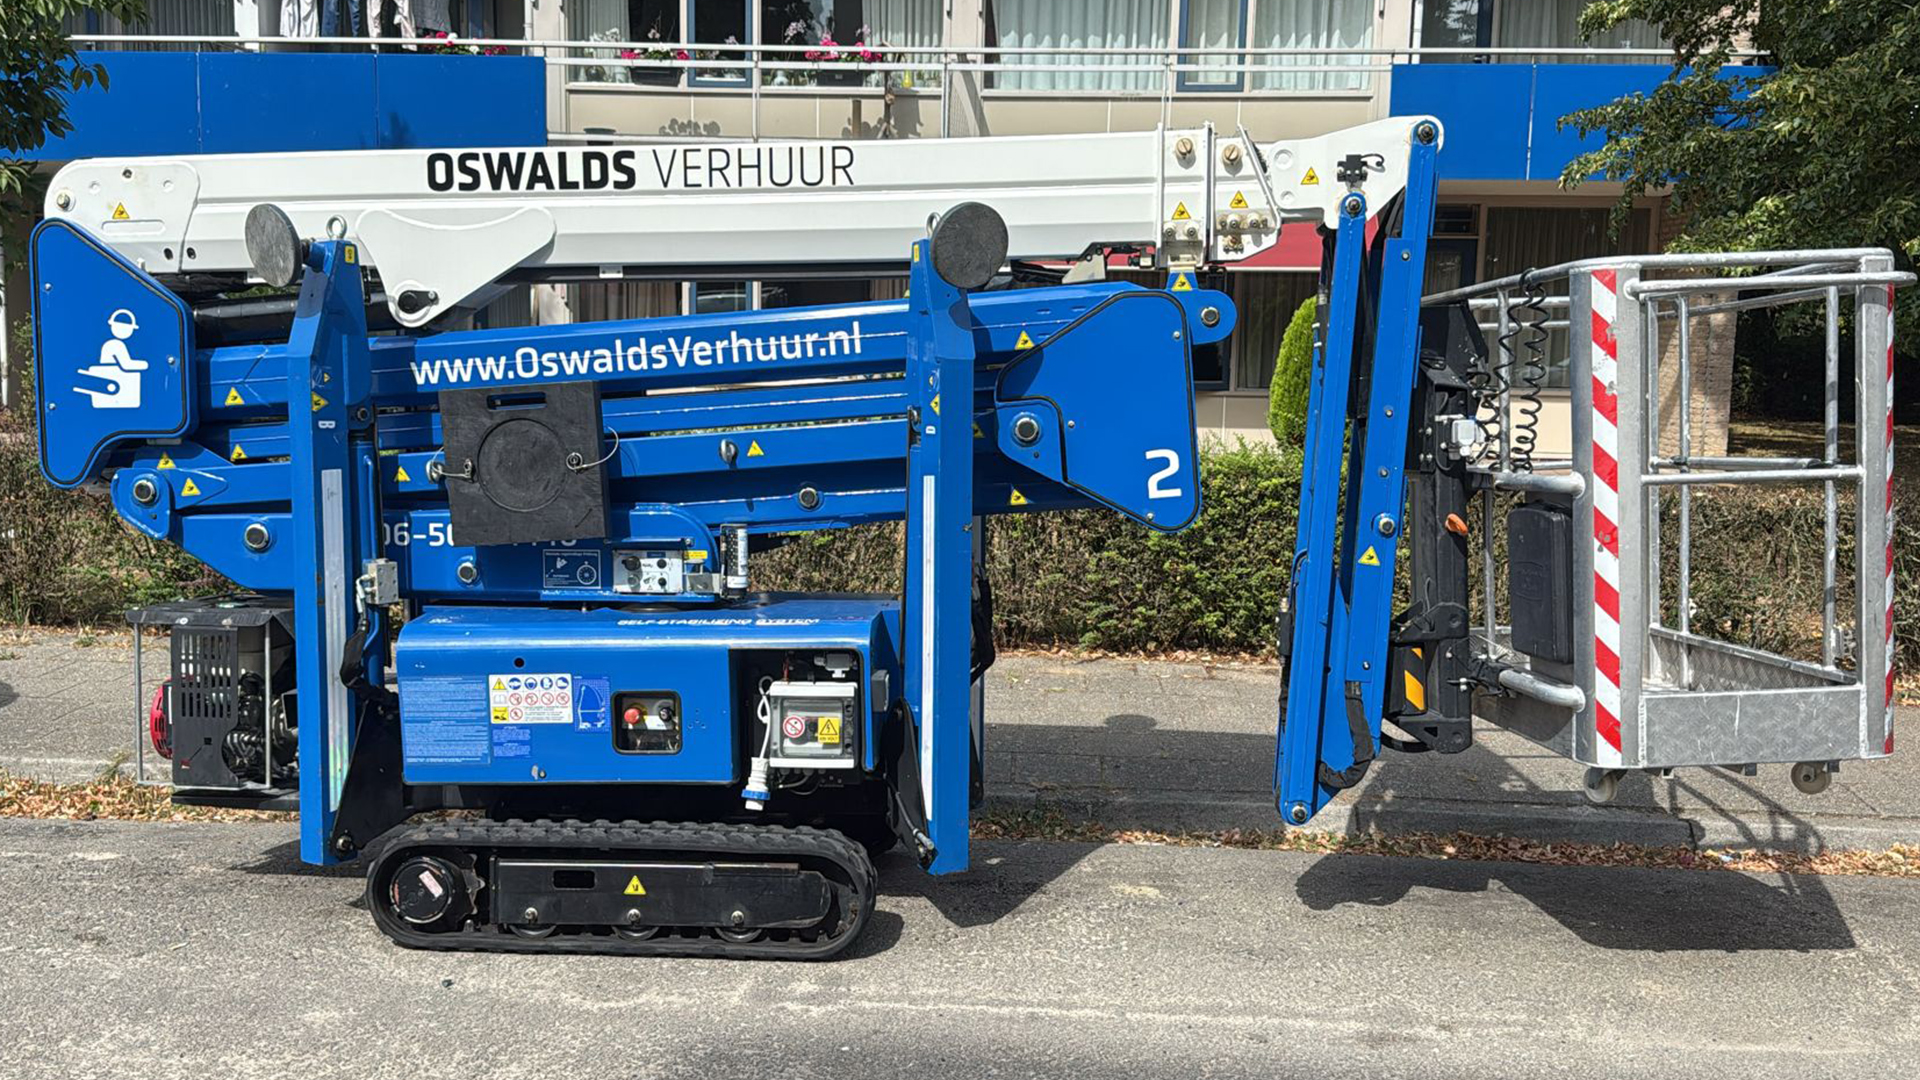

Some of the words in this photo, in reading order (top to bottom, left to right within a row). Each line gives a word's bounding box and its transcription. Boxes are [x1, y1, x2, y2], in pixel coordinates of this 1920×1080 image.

[427, 151, 636, 191] OSWALDS
[652, 146, 855, 189] VERHUUR
[410, 321, 864, 385] www.OswaldsVerhuur.nl
[1145, 447, 1182, 498] 2
